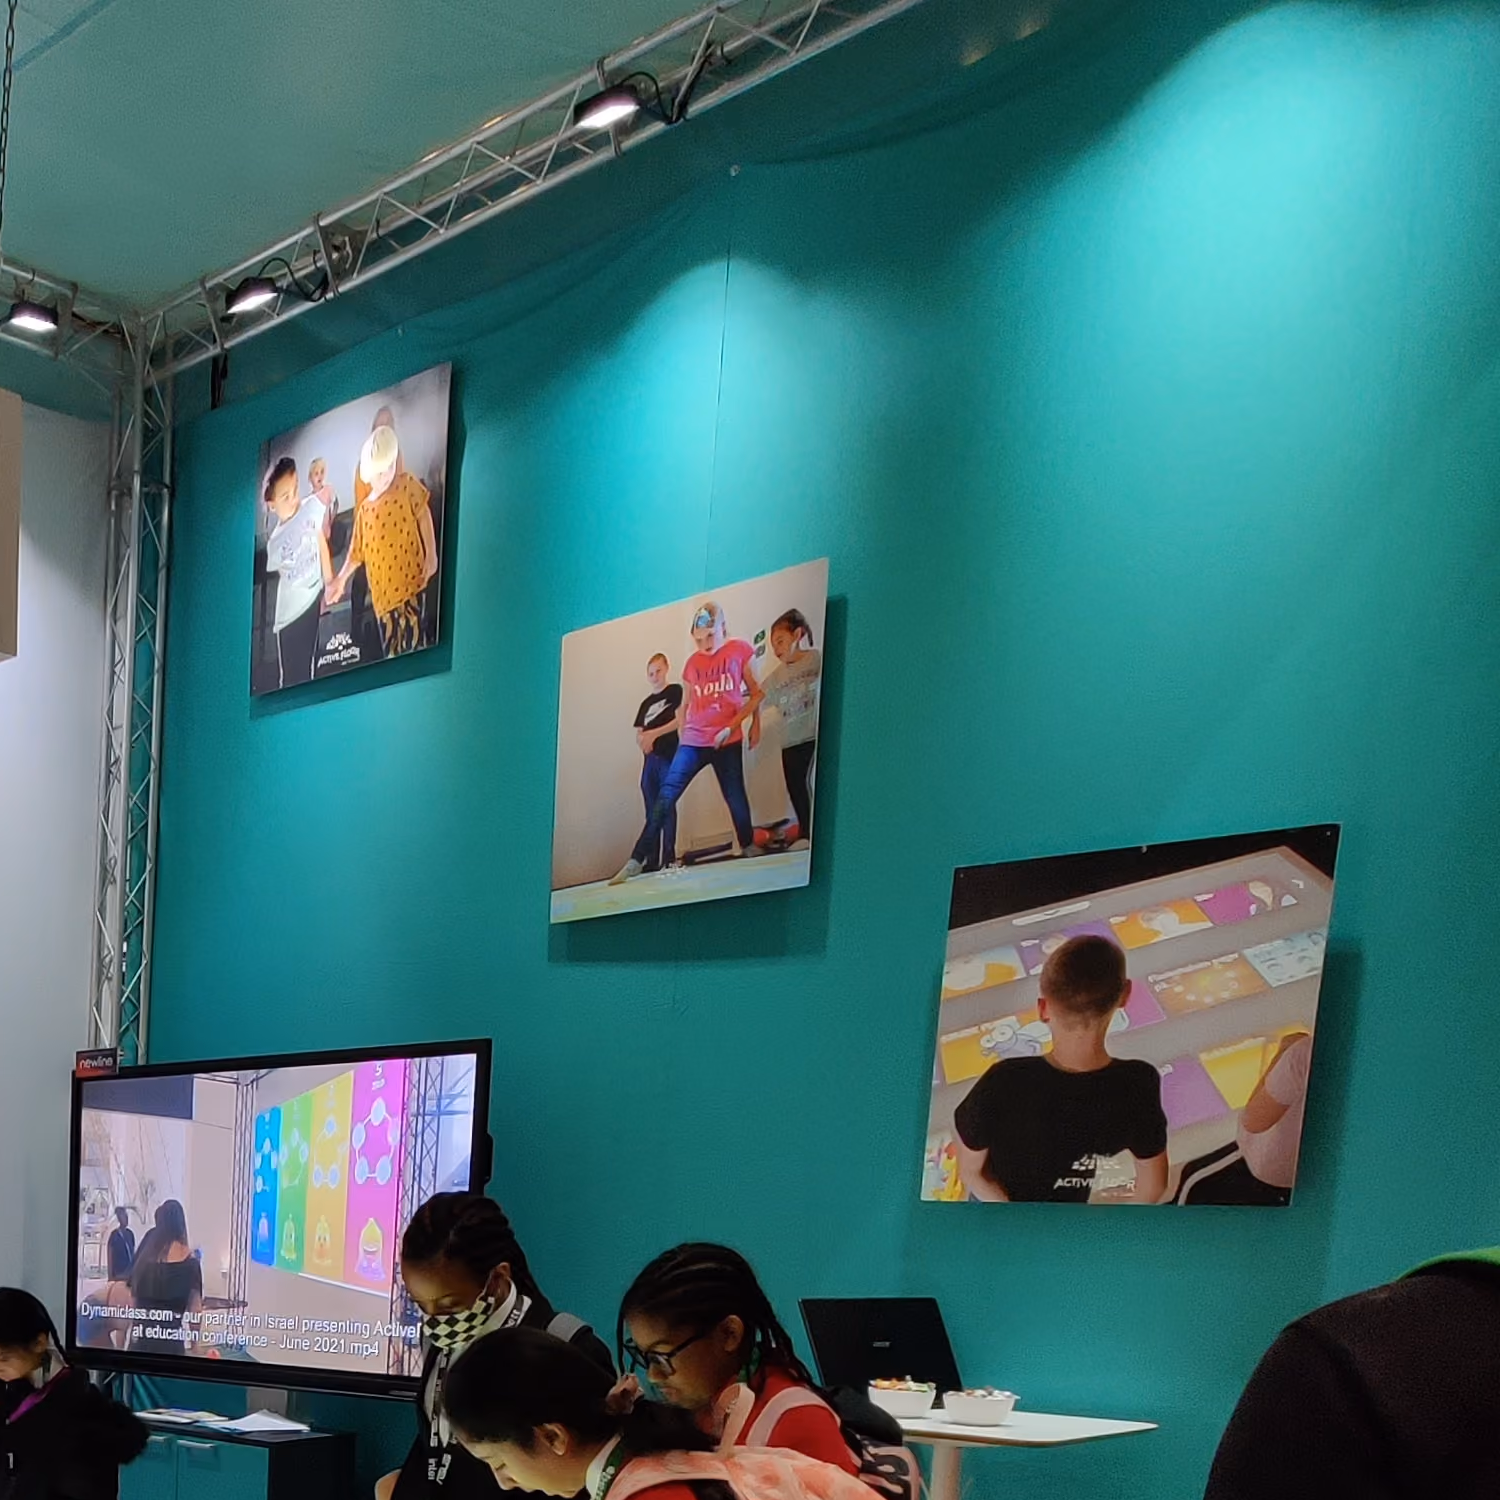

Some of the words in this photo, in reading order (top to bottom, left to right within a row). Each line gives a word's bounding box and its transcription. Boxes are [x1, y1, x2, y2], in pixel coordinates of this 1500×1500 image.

[81, 1301, 173, 1322] Dynamiclass.com
[183, 1312, 202, 1324] our
[205, 1311, 247, 1329] partner
[250, 1315, 261, 1328] in
[264, 1316, 299, 1331] Israel
[301, 1318, 370, 1338] presenting
[132, 1326, 144, 1338] at
[145, 1326, 200, 1343] education
[202, 1330, 268, 1346] conference
[279, 1335, 311, 1351] June
[313, 1336, 380, 1358] 2021.mp4
